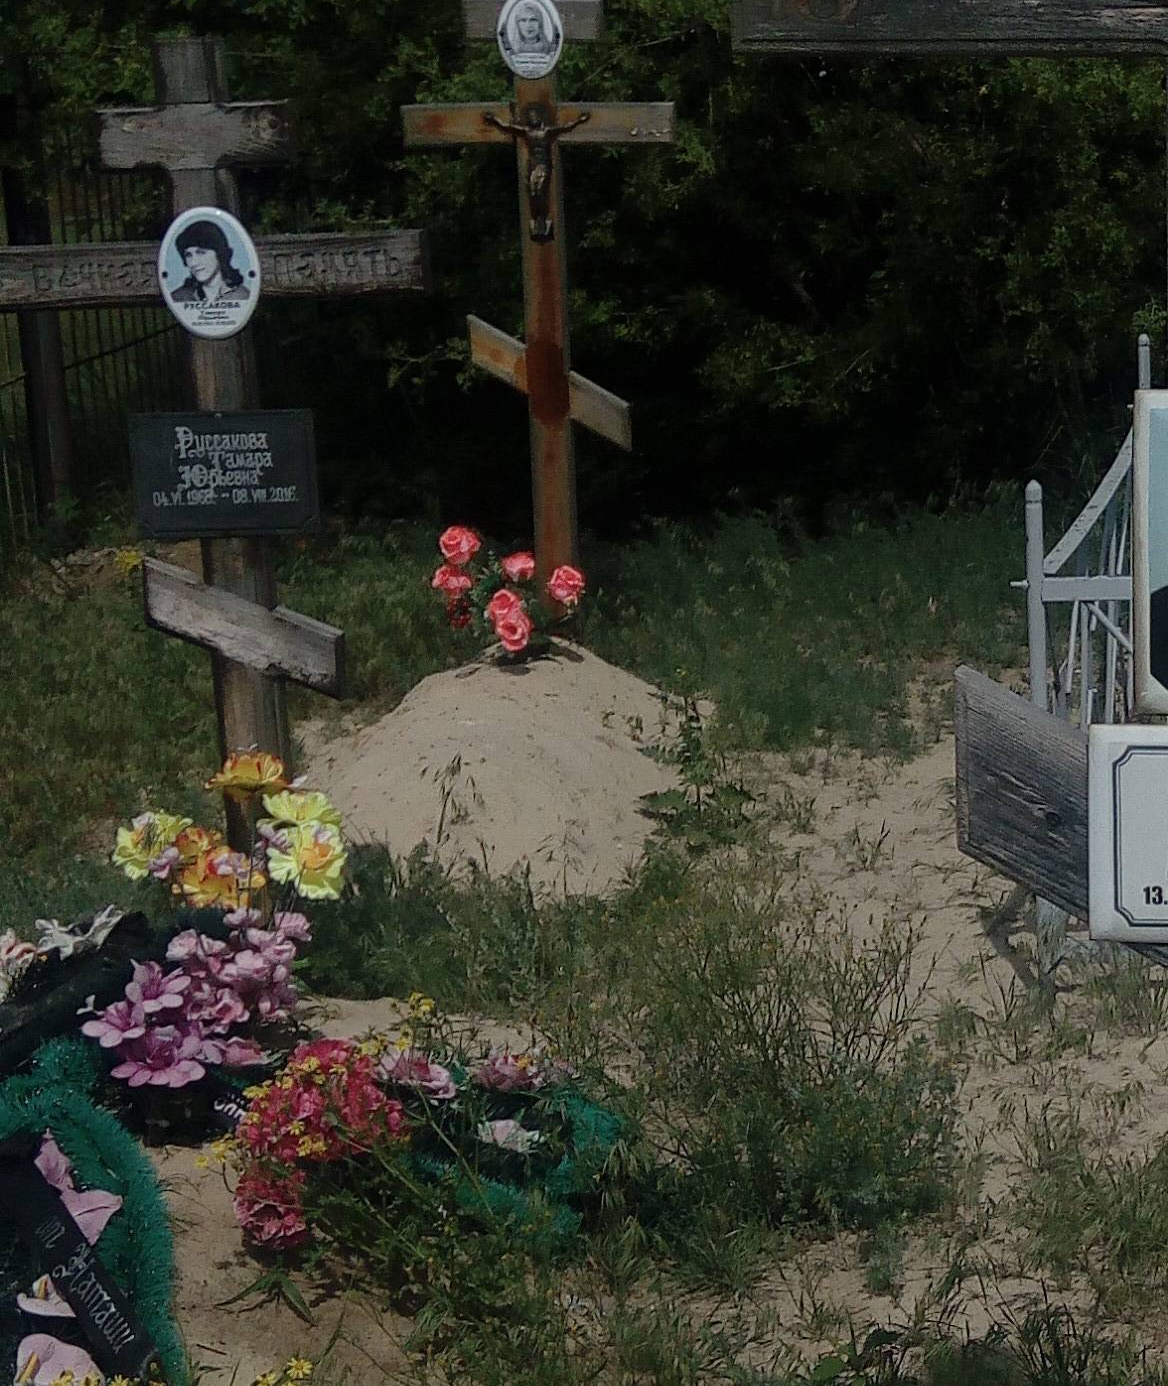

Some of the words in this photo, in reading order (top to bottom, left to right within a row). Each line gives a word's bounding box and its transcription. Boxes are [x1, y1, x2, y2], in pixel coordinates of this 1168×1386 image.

[174, 426, 269, 459] Руссакова
[208, 452, 274, 475] Тамара
[177, 464, 260, 492] Юрьевна
